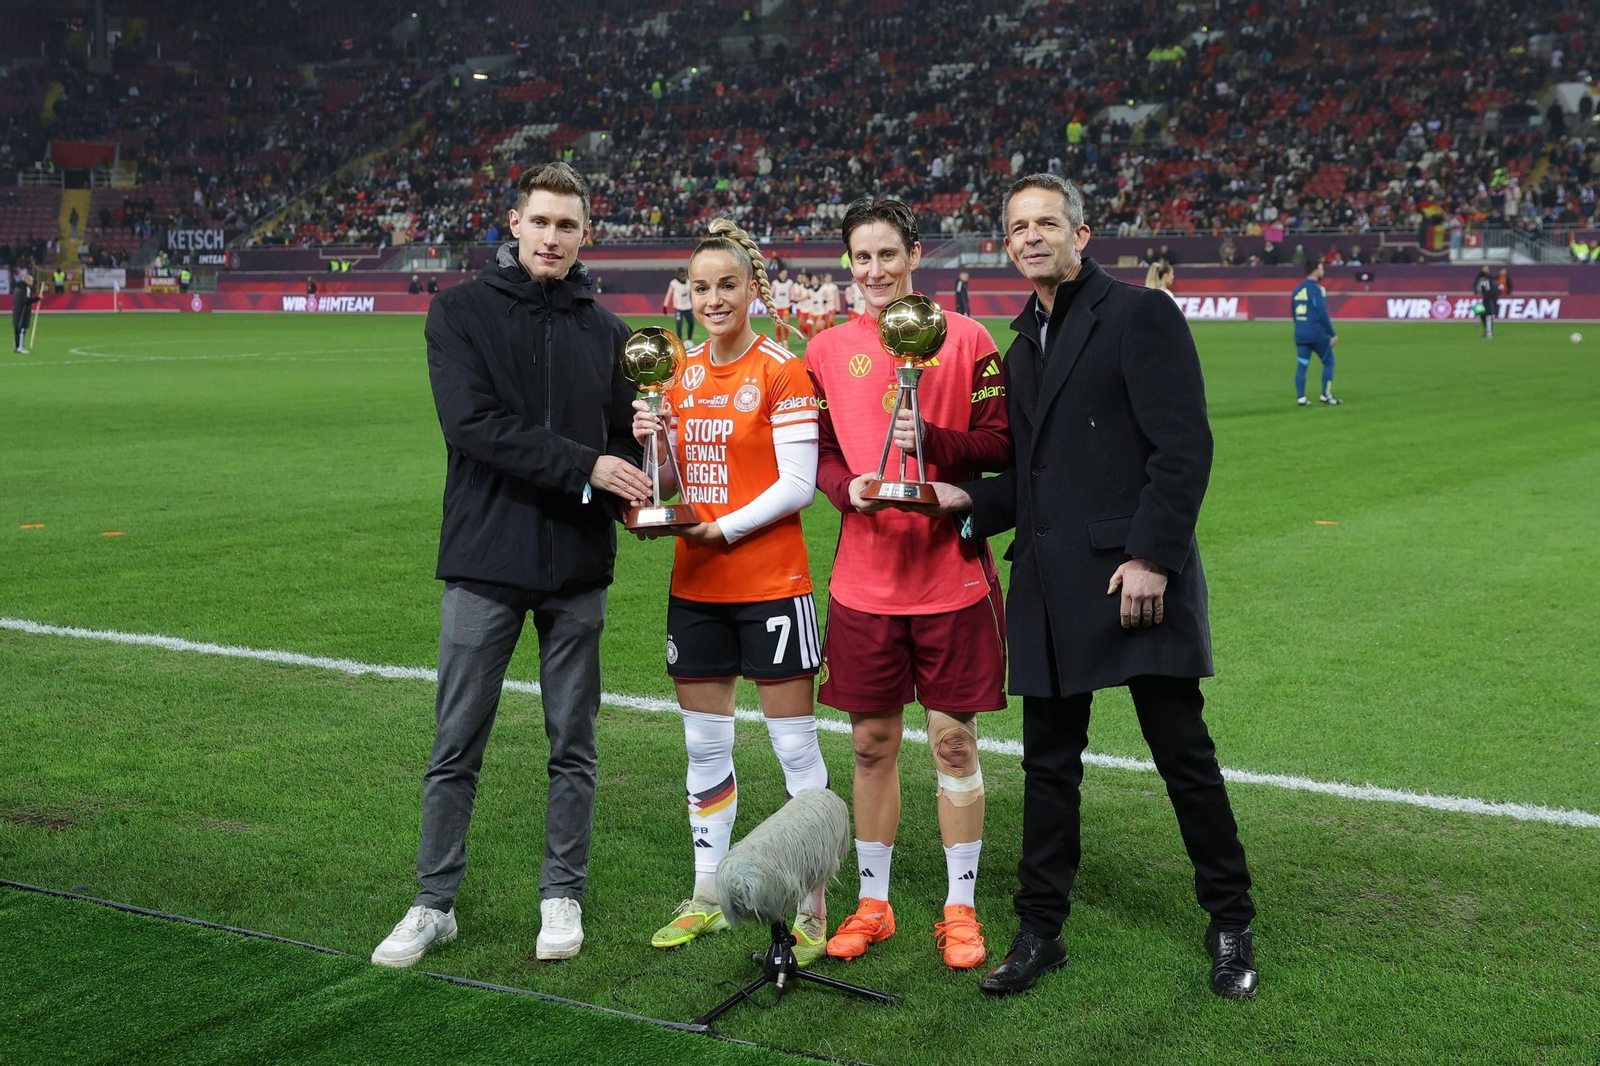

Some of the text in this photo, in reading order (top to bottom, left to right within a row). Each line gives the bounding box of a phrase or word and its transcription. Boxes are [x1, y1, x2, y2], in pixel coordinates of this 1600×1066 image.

[167, 229, 224, 250] KETSCH
[283, 296, 375, 312] WIR #IMTEAM
[1387, 299, 1432, 319] WIR
[684, 418, 734, 443] STOPP
[685, 444, 727, 462] GEWALT
[686, 463, 728, 485] GEGEN
[687, 485, 728, 505] FRAUEN
[766, 615, 792, 665] 7
